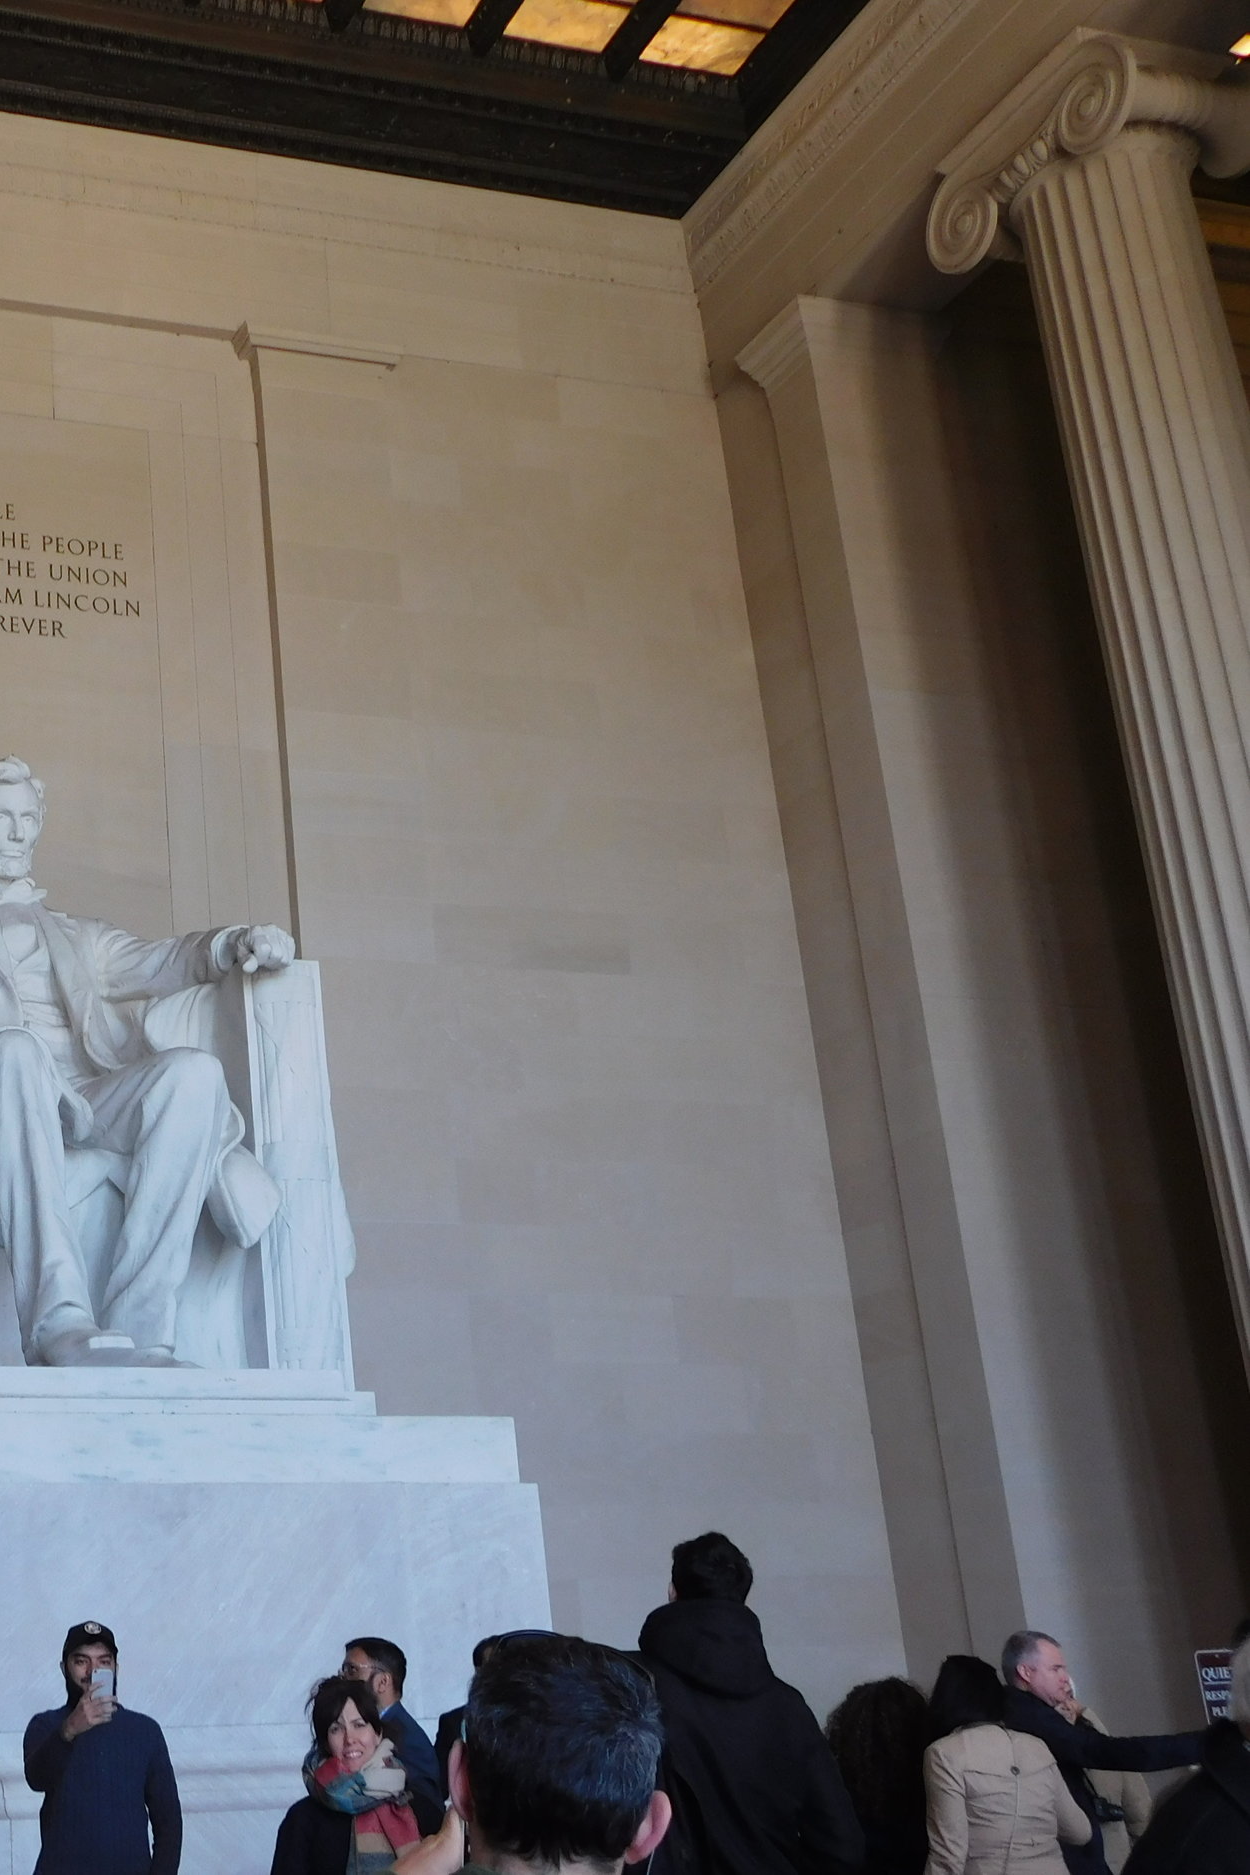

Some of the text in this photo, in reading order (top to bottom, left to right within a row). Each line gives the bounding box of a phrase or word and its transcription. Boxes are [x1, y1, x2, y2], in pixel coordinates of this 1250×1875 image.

[41, 534, 124, 561] PEOPLE
[49, 563, 128, 589] UNION
[34, 589, 141, 618] LINCOLN
[1201, 1666, 1233, 1681] QUIE
